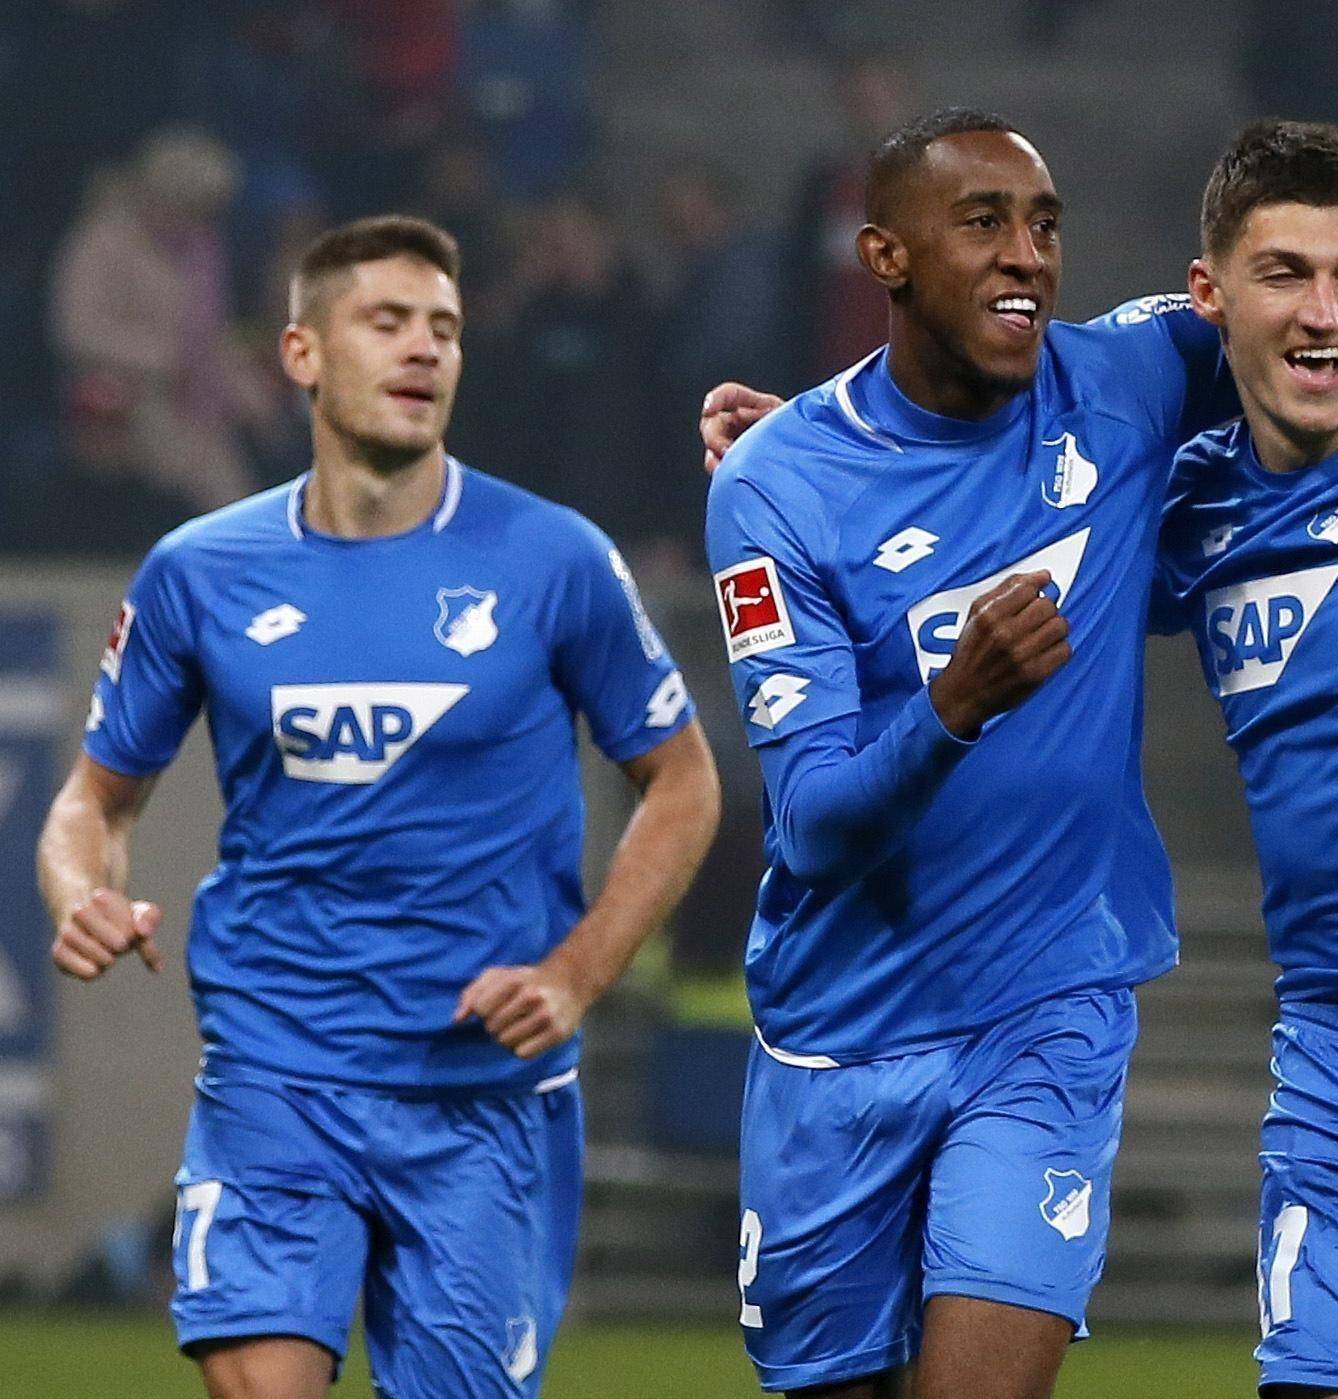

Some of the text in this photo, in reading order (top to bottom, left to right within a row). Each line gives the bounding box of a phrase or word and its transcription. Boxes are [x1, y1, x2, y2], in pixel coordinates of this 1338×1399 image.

[1208, 595, 1305, 675] SAP
[279, 706, 413, 761] SAP
[737, 1208, 764, 1329] 2
[1256, 1201, 1309, 1340] 1
